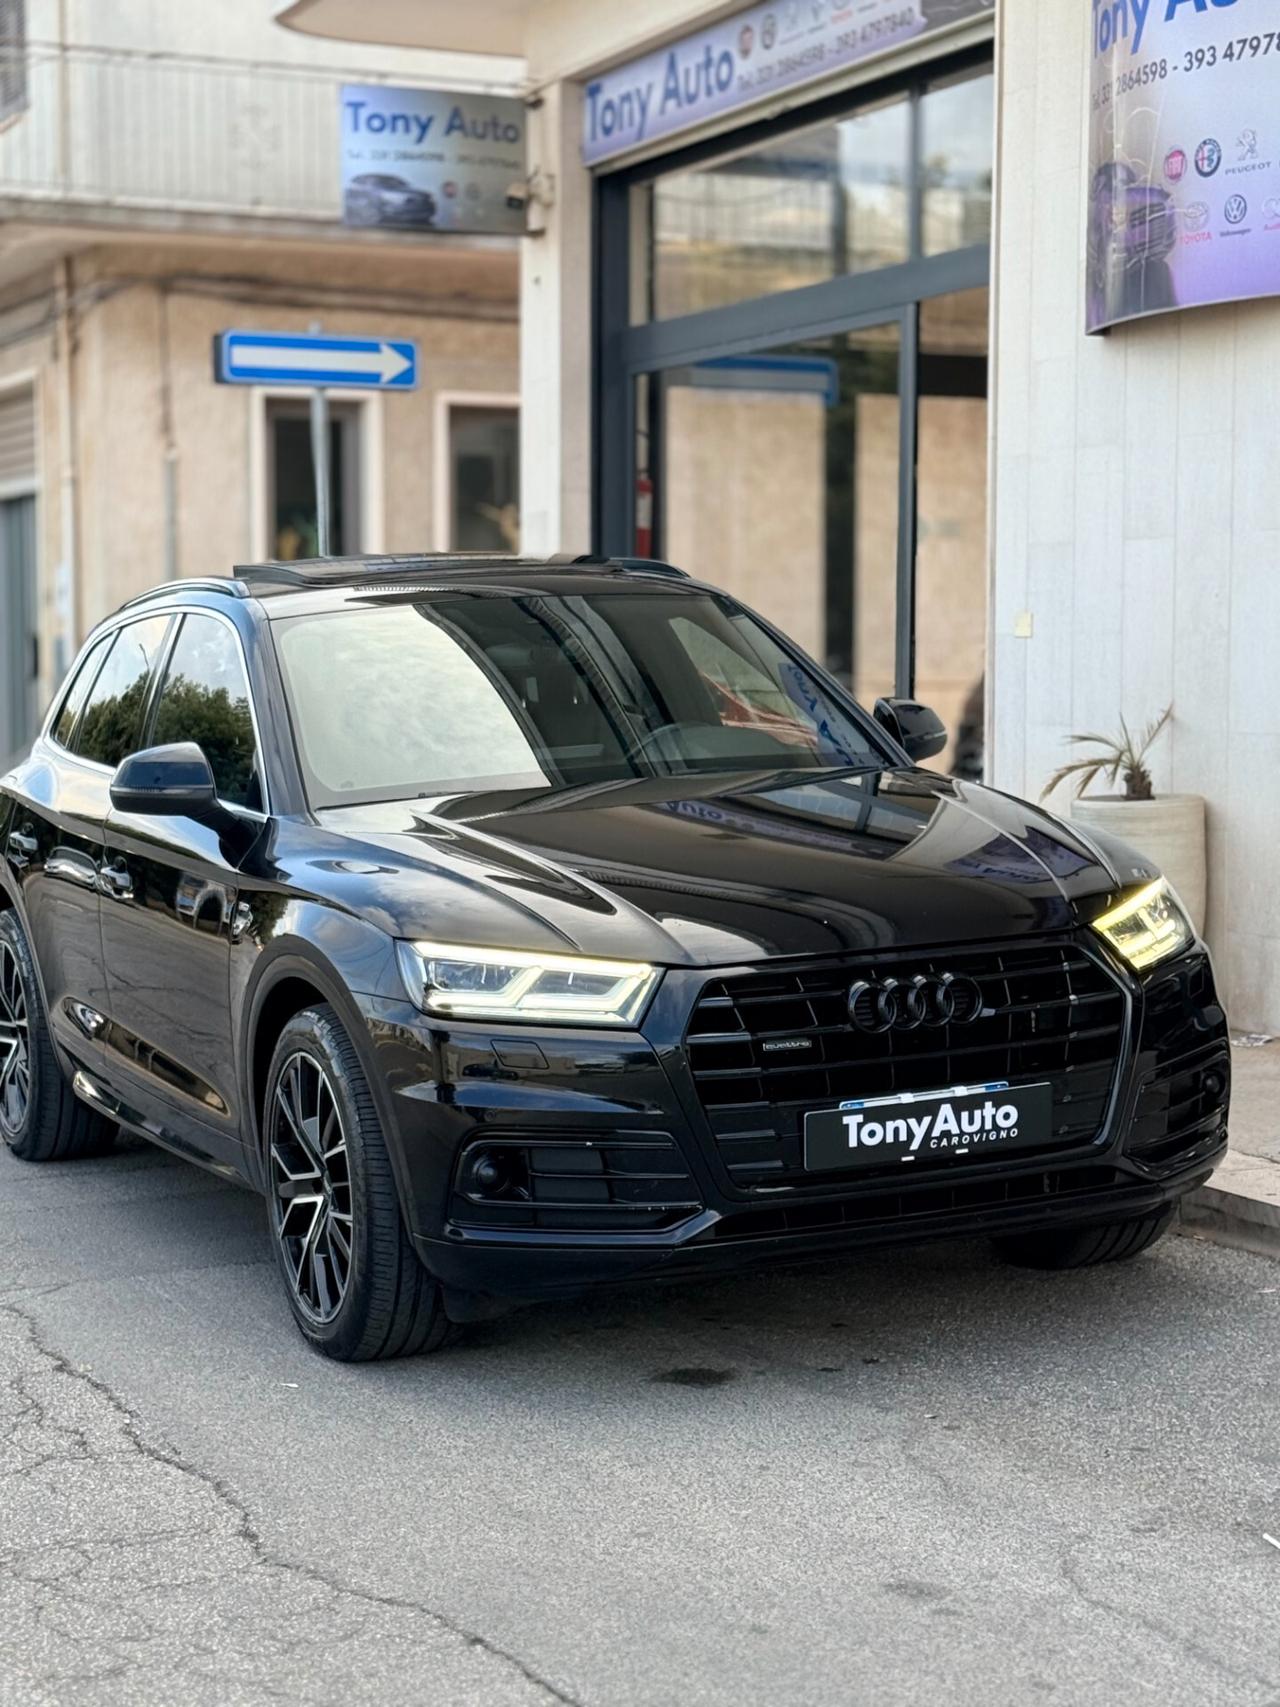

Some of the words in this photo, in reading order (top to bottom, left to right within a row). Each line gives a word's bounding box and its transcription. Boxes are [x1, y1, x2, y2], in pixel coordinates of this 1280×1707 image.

[586, 80, 653, 142] Tony
[658, 46, 734, 115] Auto
[1115, 58, 1168, 96] 2864598
[1184, 45, 1217, 72] 393
[345, 101, 434, 144] Tony
[444, 106, 520, 144] Auto
[930, 1129, 1019, 1149] CAROVIGNO
